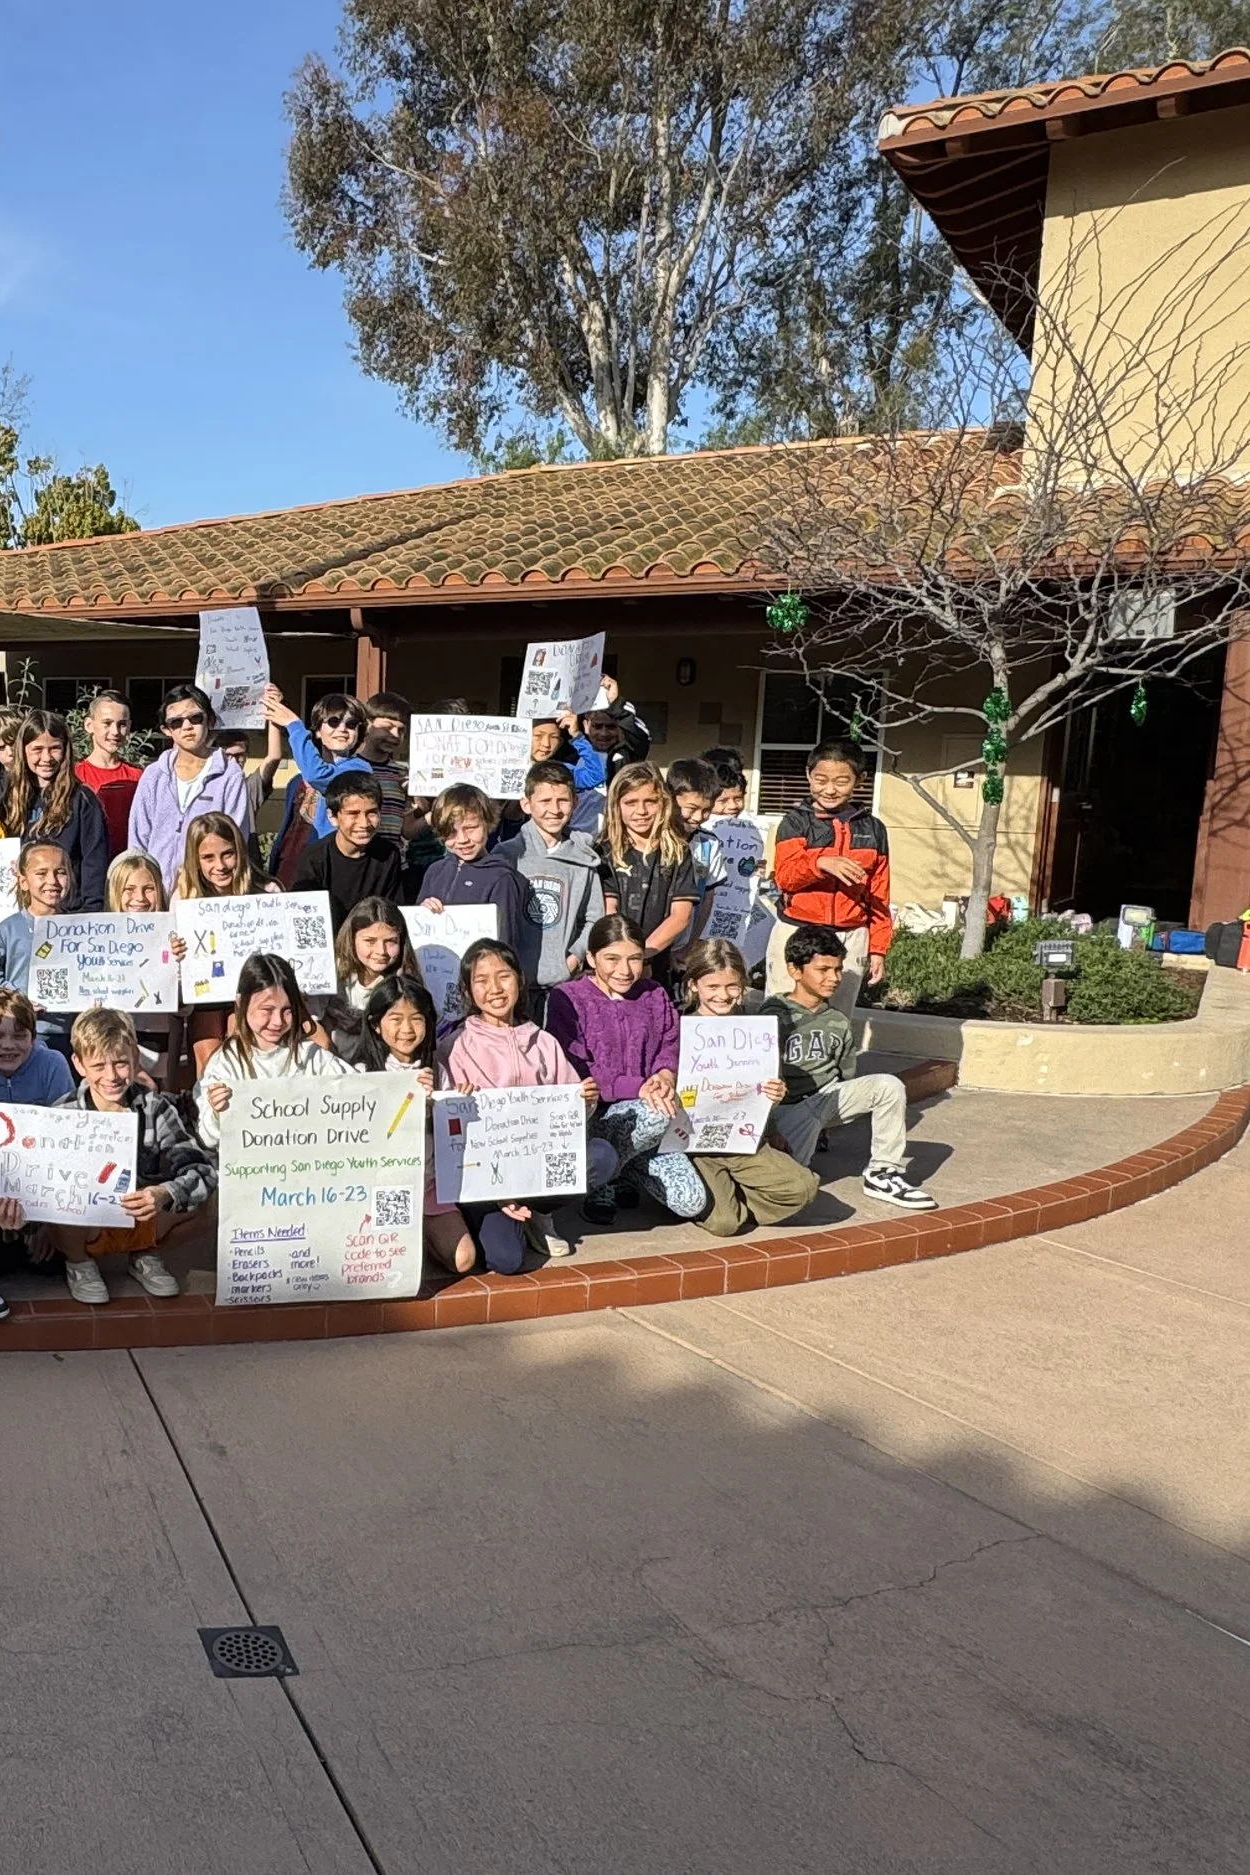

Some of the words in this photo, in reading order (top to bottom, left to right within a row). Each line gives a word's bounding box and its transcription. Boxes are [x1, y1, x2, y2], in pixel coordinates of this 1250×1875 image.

[46, 919, 116, 940] Donation
[126, 917, 156, 935] Drive
[60, 938, 84, 954] For
[88, 937, 106, 953] San
[108, 940, 144, 956] Diego
[693, 1023, 726, 1052] San
[783, 1029, 844, 1065] GAP
[250, 1096, 310, 1120] School
[320, 1094, 377, 1122] Supply
[530, 1090, 570, 1106] Services
[241, 1129, 318, 1149] Donation
[327, 1127, 370, 1145] Drive
[0, 1150, 89, 1190] Drive
[224, 1163, 287, 1182] Supporting
[290, 1159, 311, 1172] San
[315, 1159, 345, 1177] Diego
[346, 1156, 378, 1169] Youth
[380, 1155, 422, 1167] Services
[3, 1176, 84, 1207] March
[88, 1191, 120, 1206] 16-2
[261, 1185, 316, 1208] March
[321, 1185, 368, 1204] 16-23
[231, 1227, 265, 1240] Items
[267, 1223, 306, 1238] Needed
[378, 1232, 399, 1243] QR
[291, 1247, 311, 1258] and
[375, 1248, 387, 1258] to
[232, 1259, 270, 1270] Erasers
